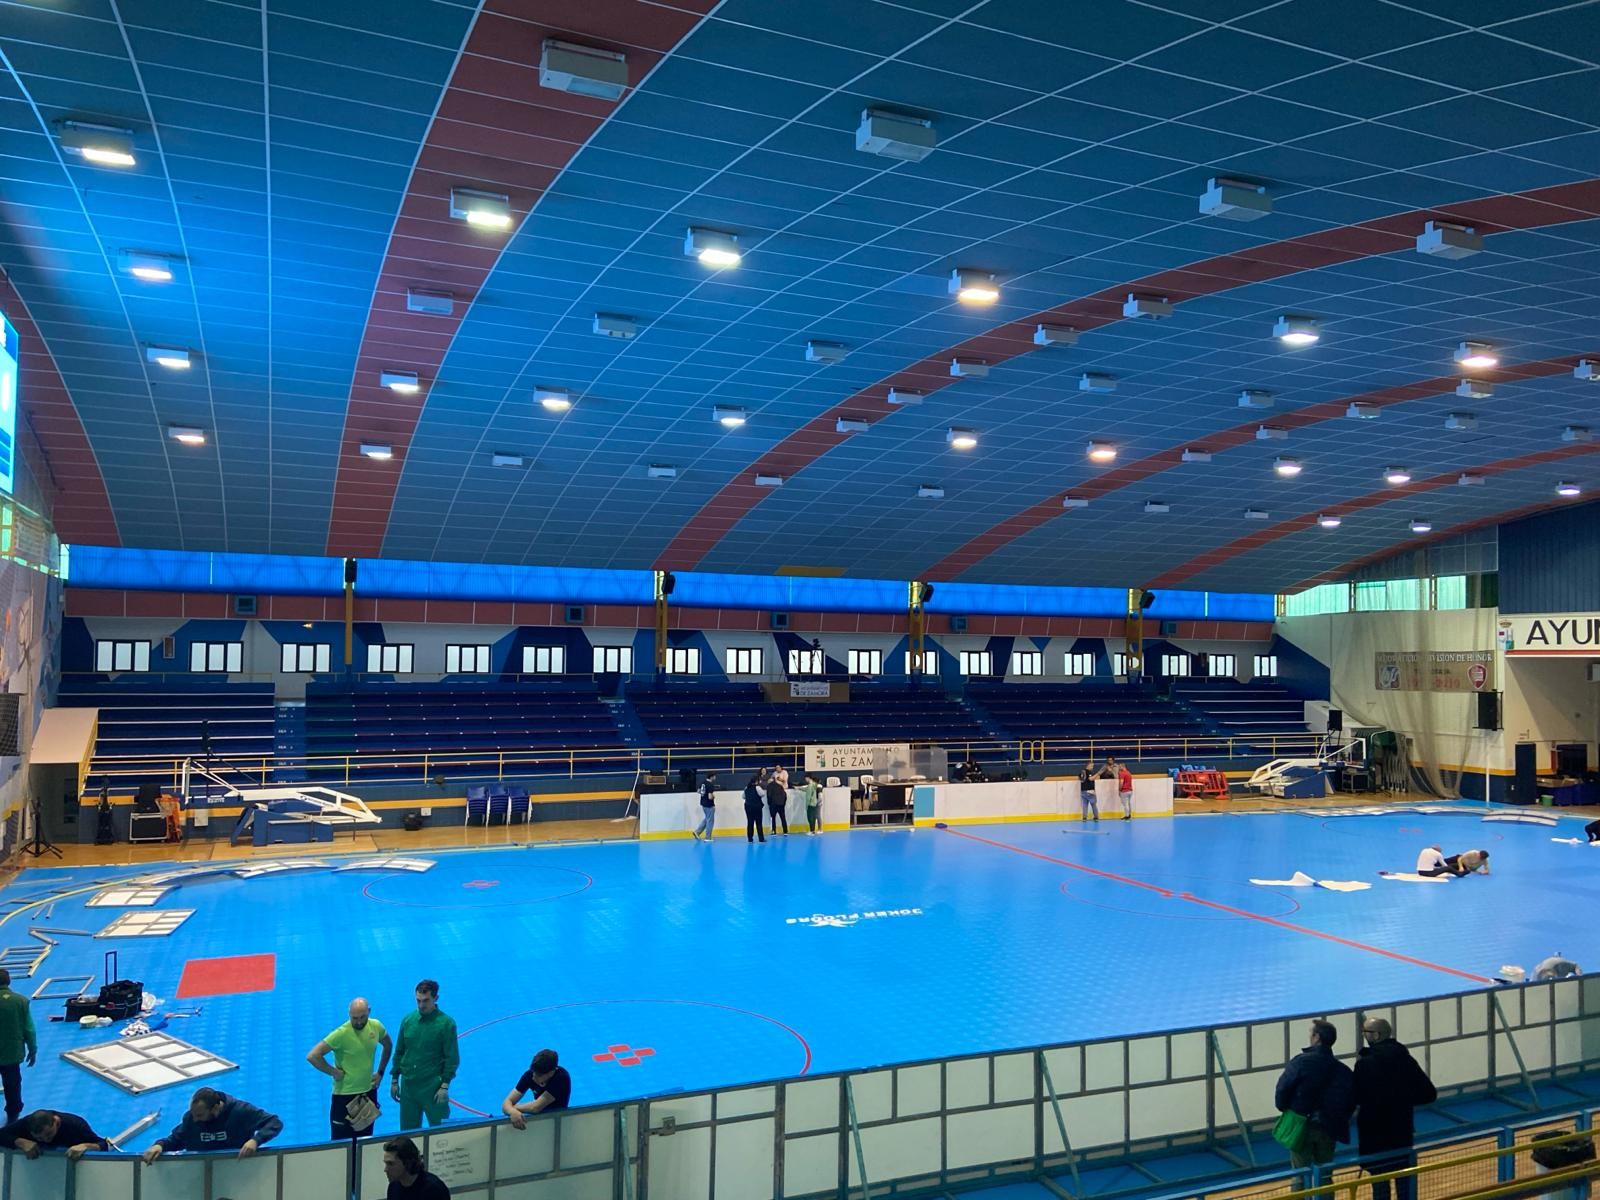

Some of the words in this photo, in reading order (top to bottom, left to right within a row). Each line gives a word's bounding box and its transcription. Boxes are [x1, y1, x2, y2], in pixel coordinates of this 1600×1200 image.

[832, 747, 900, 755] AYUNTAMNO
[832, 757, 846, 767] DE
[863, 907, 923, 918] JOKER
[785, 913, 859, 924] FLOORS
